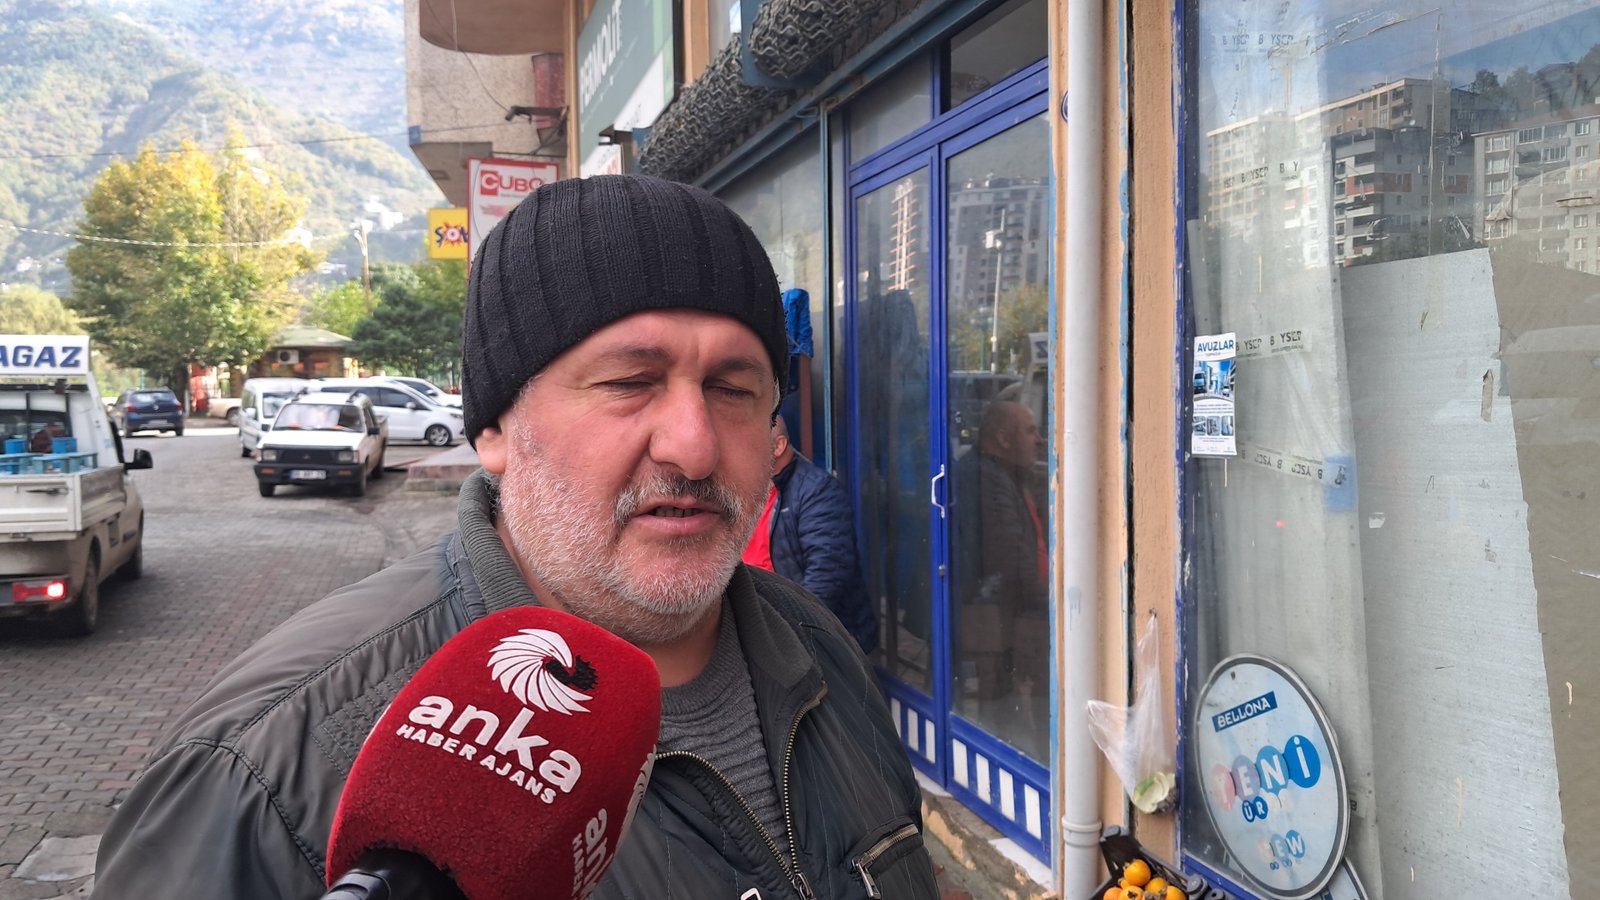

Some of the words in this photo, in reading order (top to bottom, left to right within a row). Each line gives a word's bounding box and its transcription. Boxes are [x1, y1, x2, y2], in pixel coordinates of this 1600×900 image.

[408, 695, 582, 794] anka
[1217, 697, 1271, 729] BELLONA
[396, 724, 477, 761] HABER
[479, 754, 557, 805] AJANS
